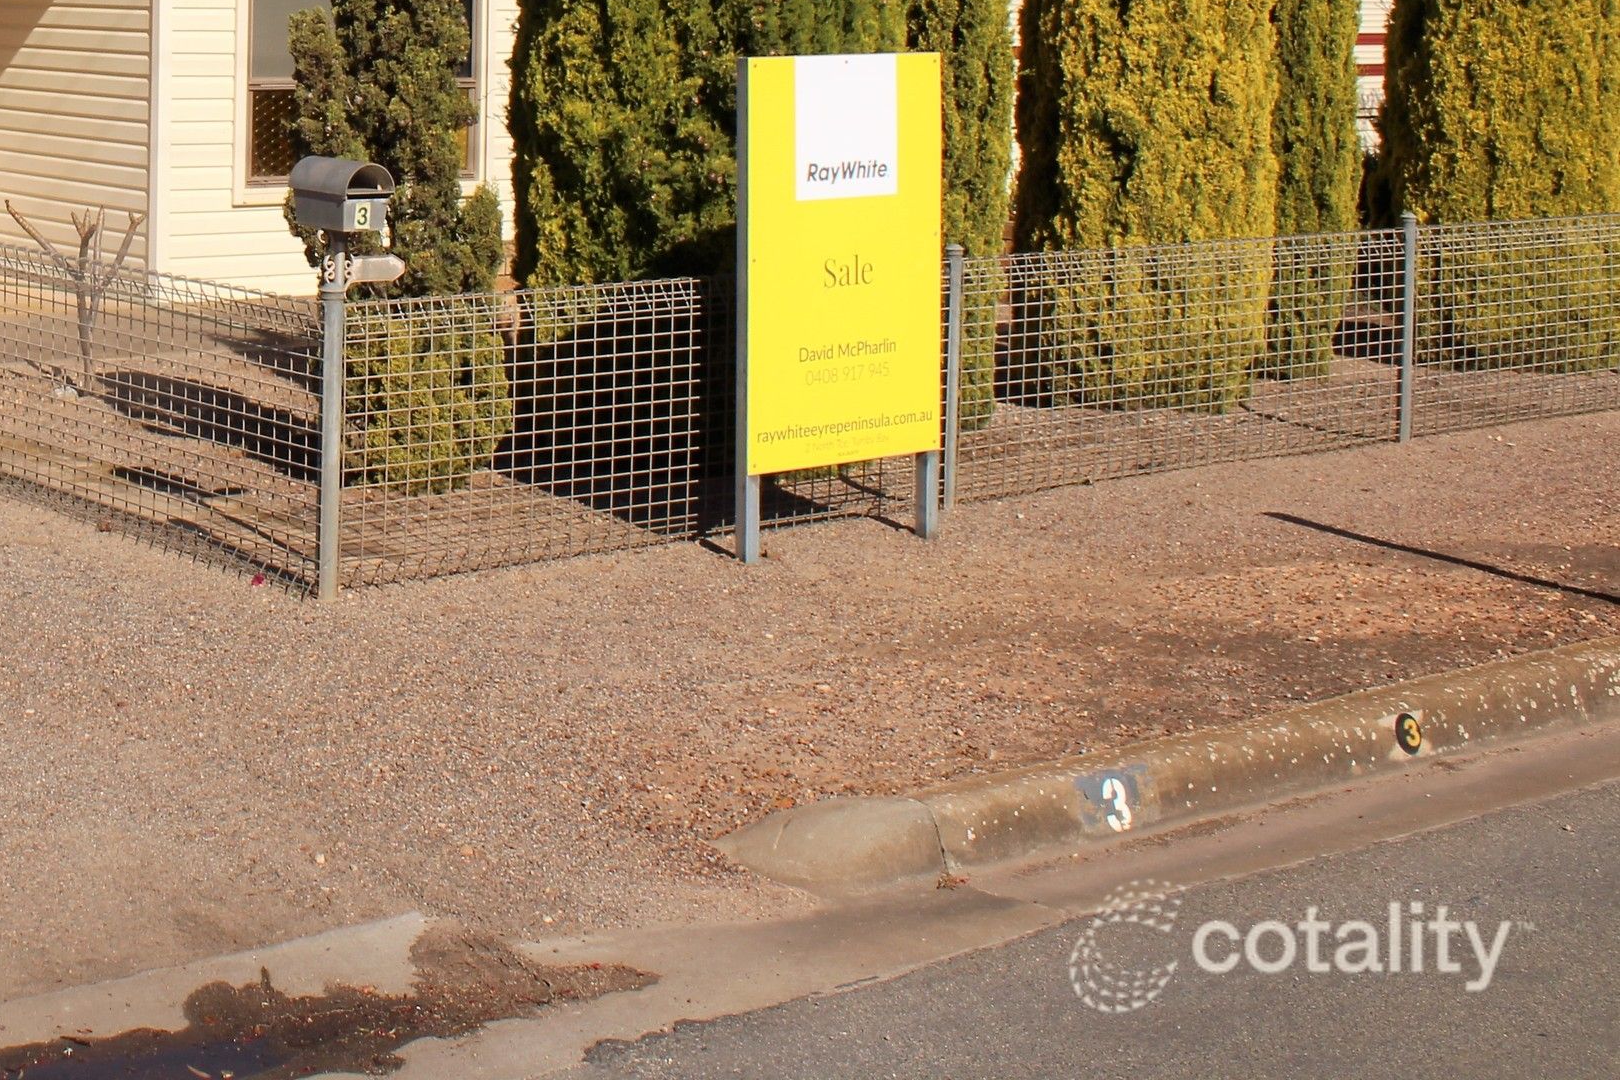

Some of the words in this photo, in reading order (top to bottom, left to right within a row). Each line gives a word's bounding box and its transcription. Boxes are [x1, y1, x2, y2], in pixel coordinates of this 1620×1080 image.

[357, 207, 368, 225] 3
[823, 254, 873, 288] Sale
[799, 344, 834, 363] David
[838, 338, 897, 358] McPharlin
[805, 368, 838, 386] 0408
[843, 364, 865, 381] 917
[868, 361, 890, 377] 945
[757, 410, 932, 444] raywhiteeyrepeninsula.com.au
[1404, 718, 1420, 747] 3
[1102, 777, 1132, 833] 3
